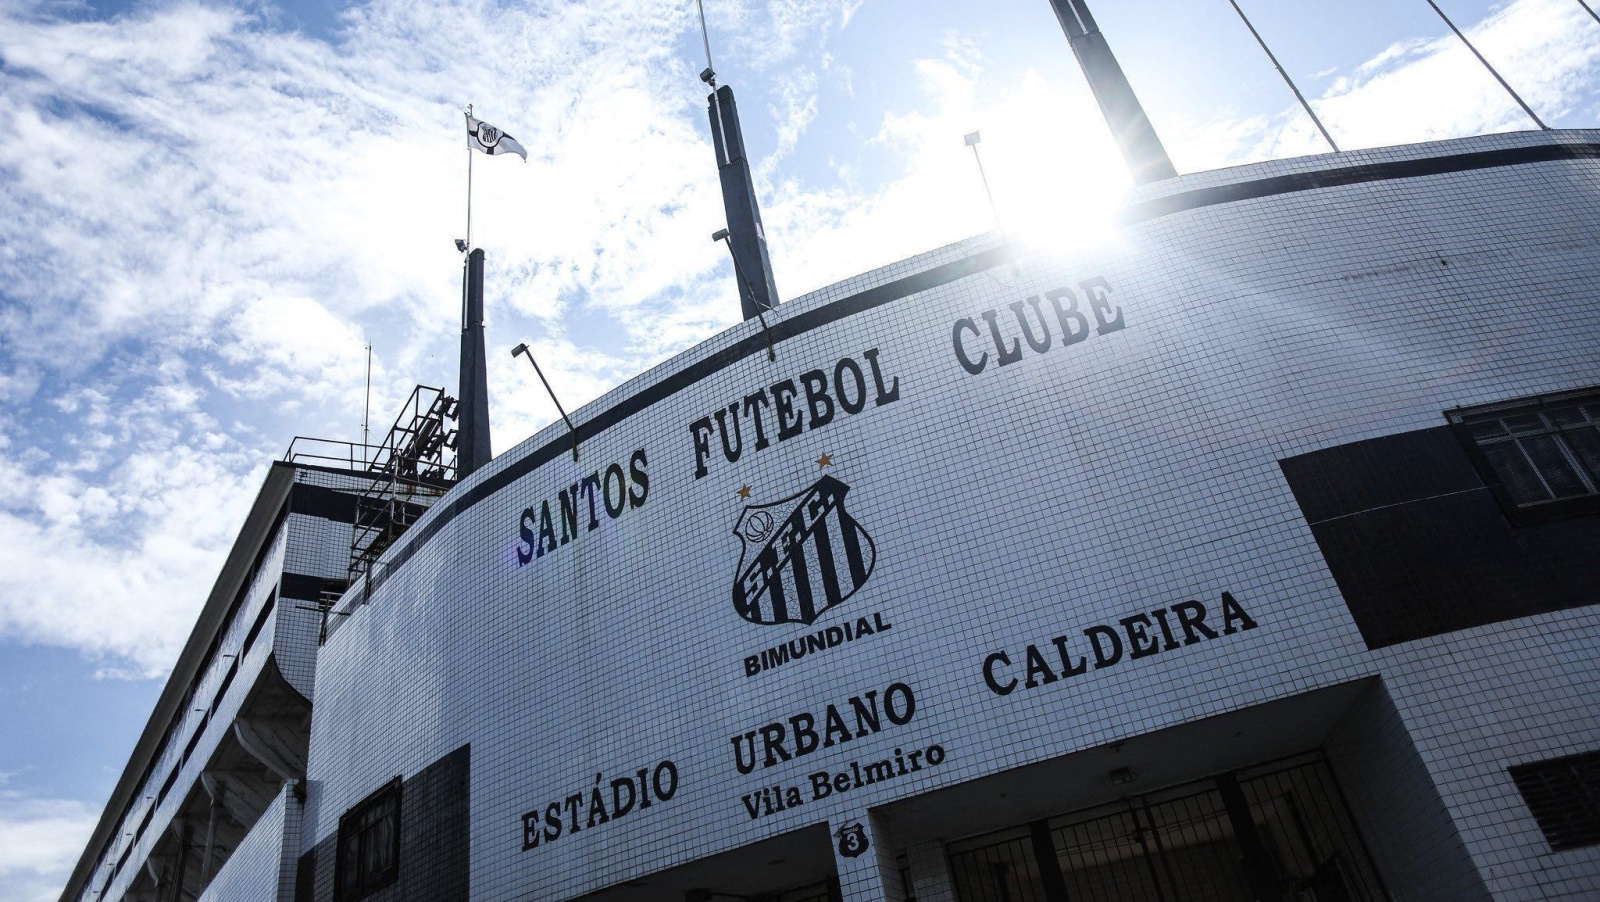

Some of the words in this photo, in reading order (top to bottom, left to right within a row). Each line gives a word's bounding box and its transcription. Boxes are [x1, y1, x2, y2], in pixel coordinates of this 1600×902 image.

[517, 447, 649, 565] SANTOS
[689, 348, 899, 479] FUTEBOL
[952, 276, 1126, 375] CLUBE
[743, 612, 892, 678] BIMUNDIAL
[522, 760, 679, 850] ESTÁDIO
[731, 683, 915, 775] URBANO
[983, 591, 1257, 696] CALDEIRA
[741, 783, 804, 820] Vila
[809, 744, 946, 801] Belmiro
[846, 832, 860, 851] 3
